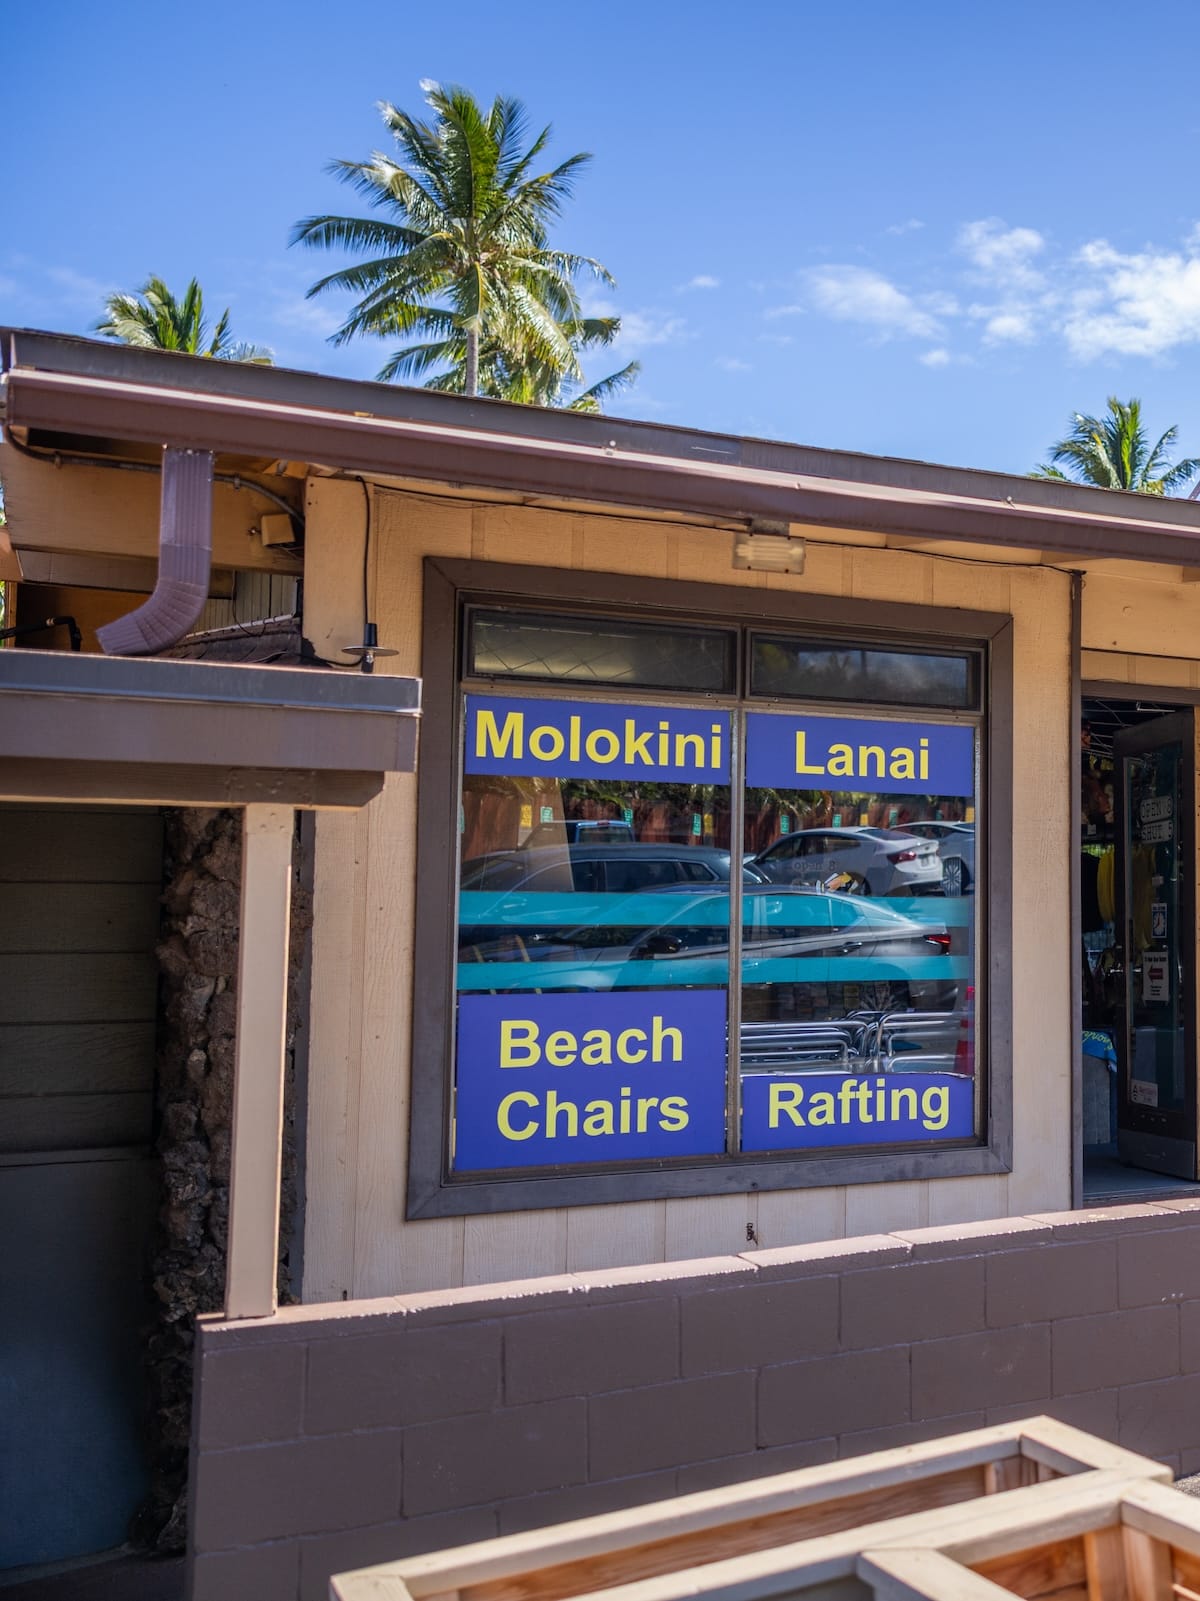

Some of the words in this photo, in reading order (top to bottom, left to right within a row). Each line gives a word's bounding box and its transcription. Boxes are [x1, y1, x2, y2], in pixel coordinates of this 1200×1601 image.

[475, 709, 722, 769] Molokini
[795, 730, 929, 780] Lanai
[499, 1016, 683, 1069] Beach
[497, 1087, 689, 1141] Chairs
[769, 1079, 949, 1130] Rafting
